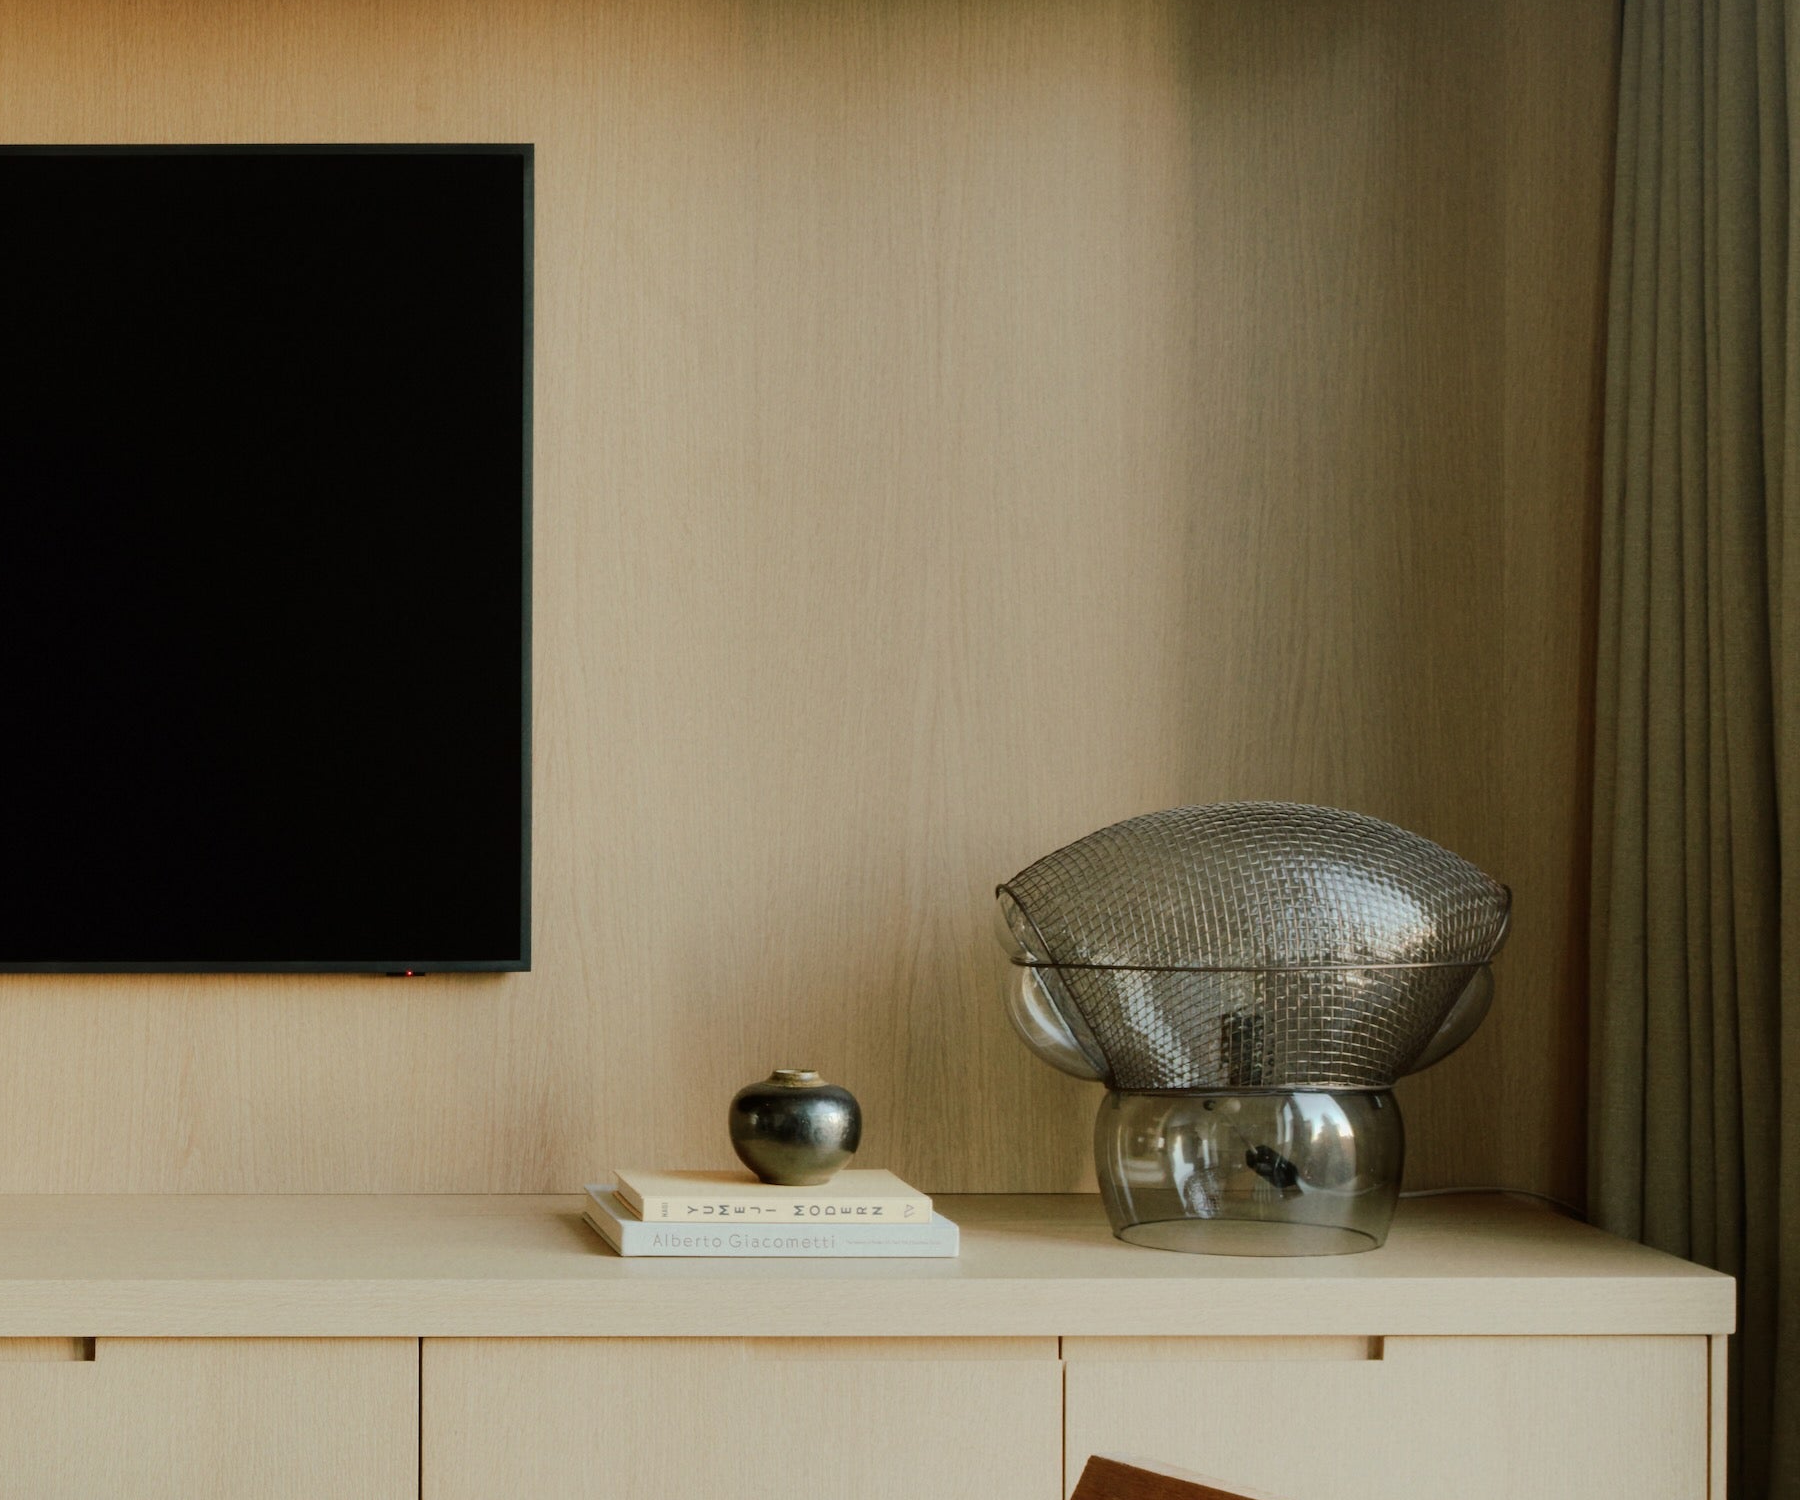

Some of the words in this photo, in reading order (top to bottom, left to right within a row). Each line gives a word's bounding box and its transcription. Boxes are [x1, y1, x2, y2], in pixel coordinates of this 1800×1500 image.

[687, 1205, 777, 1216] YUMEJI
[793, 1205, 883, 1216] MODERN
[652, 1234, 722, 1249] Alberto
[729, 1234, 835, 1249] Giacometti
